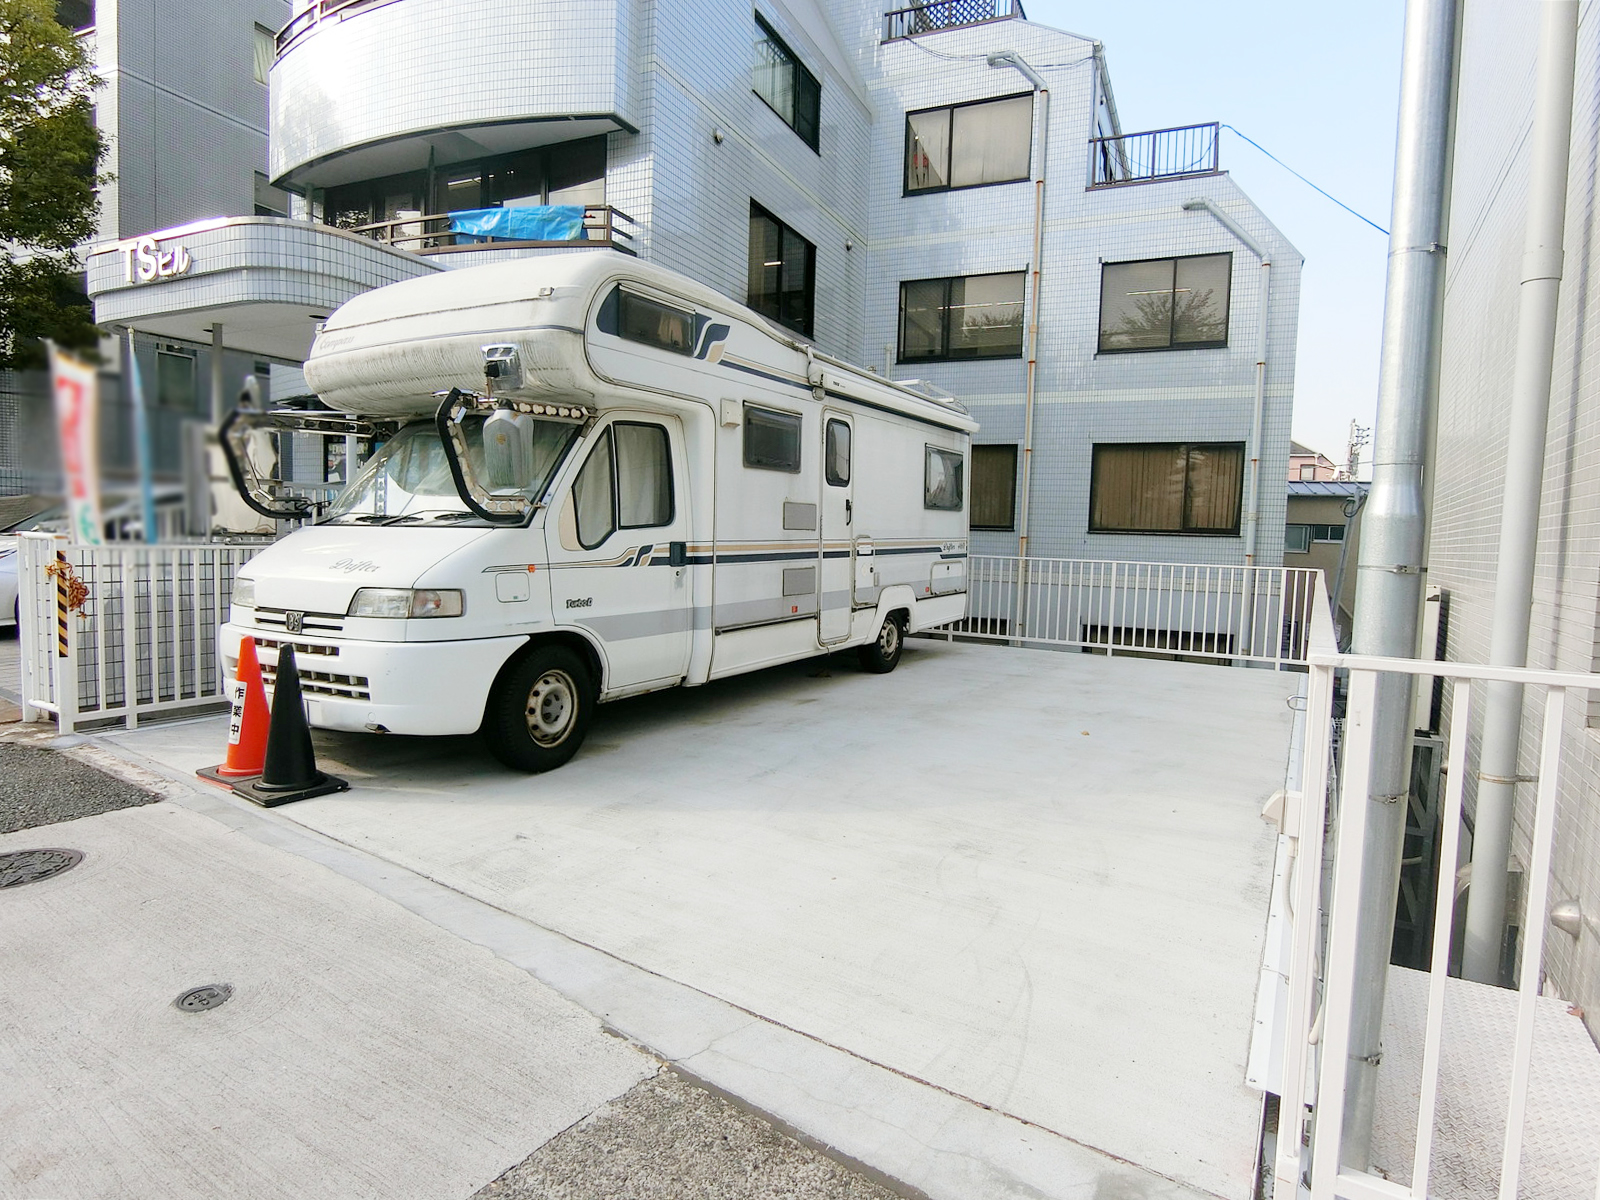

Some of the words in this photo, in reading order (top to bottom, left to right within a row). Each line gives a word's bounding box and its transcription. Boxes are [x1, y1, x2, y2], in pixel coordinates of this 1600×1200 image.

[118, 237, 192, 283] TSビル
[329, 557, 381, 574] Drifter
[230, 686, 245, 736] 作業中
